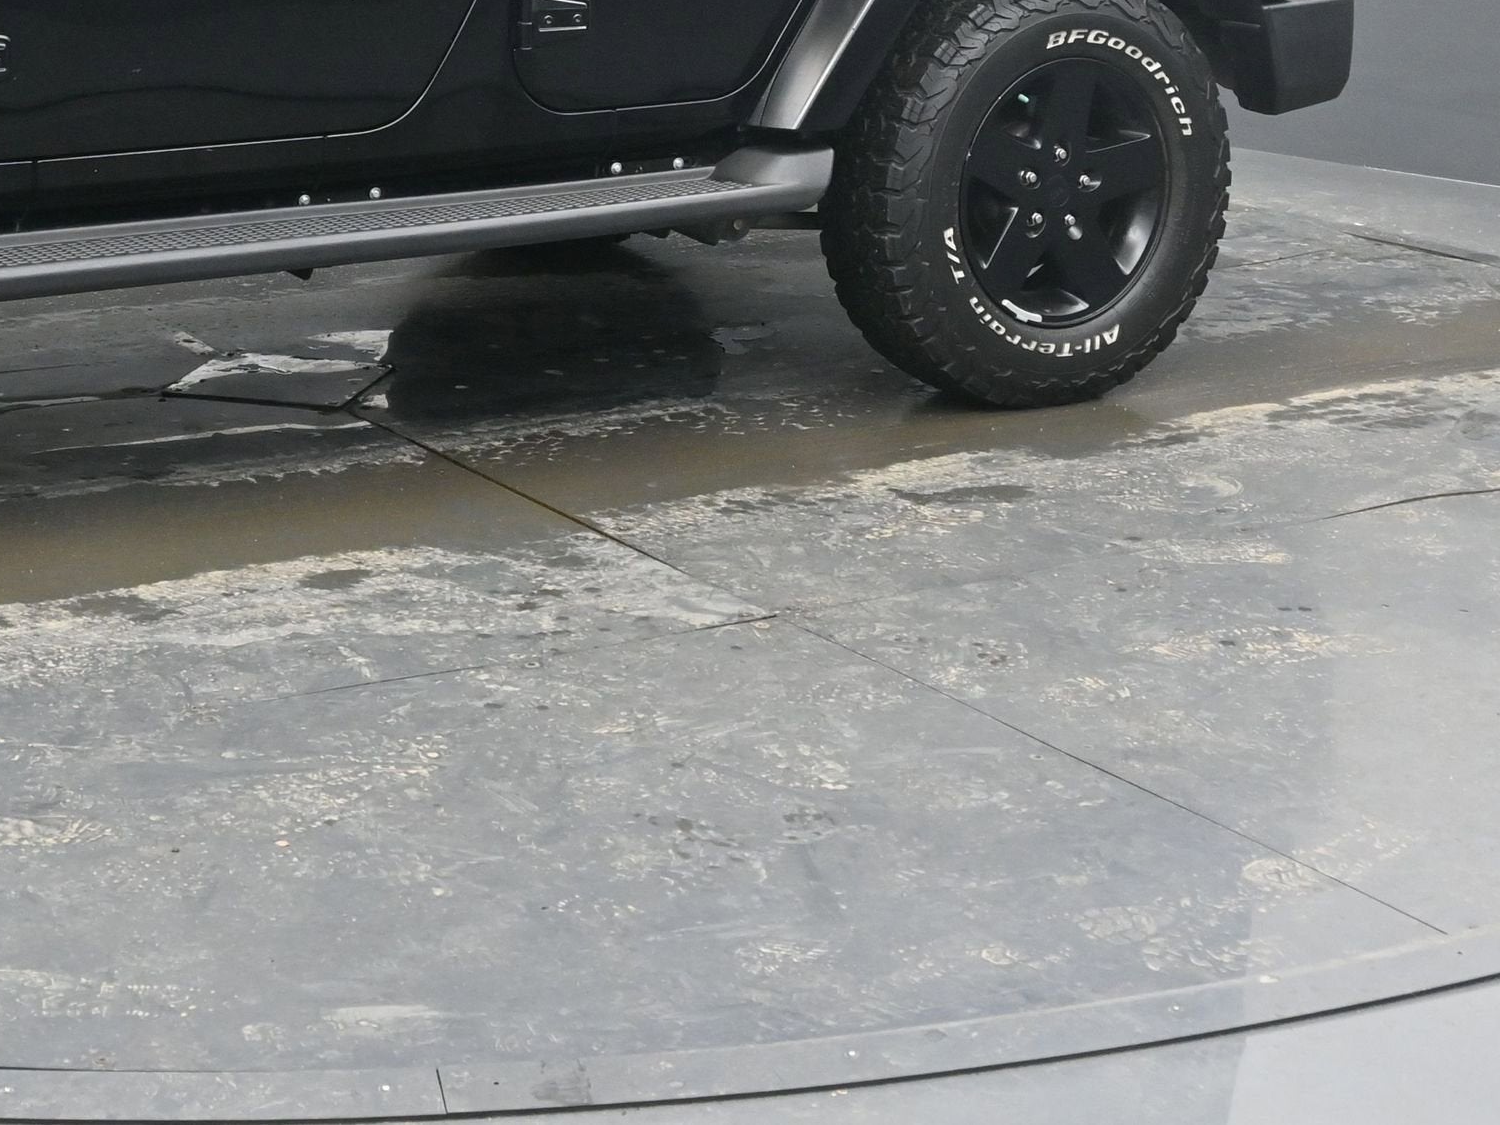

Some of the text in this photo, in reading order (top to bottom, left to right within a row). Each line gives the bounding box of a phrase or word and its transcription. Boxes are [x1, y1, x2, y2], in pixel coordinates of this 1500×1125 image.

[1047, 29, 1193, 136] BFGoodrich
[942, 227, 1120, 357] All-Terrain T/A
